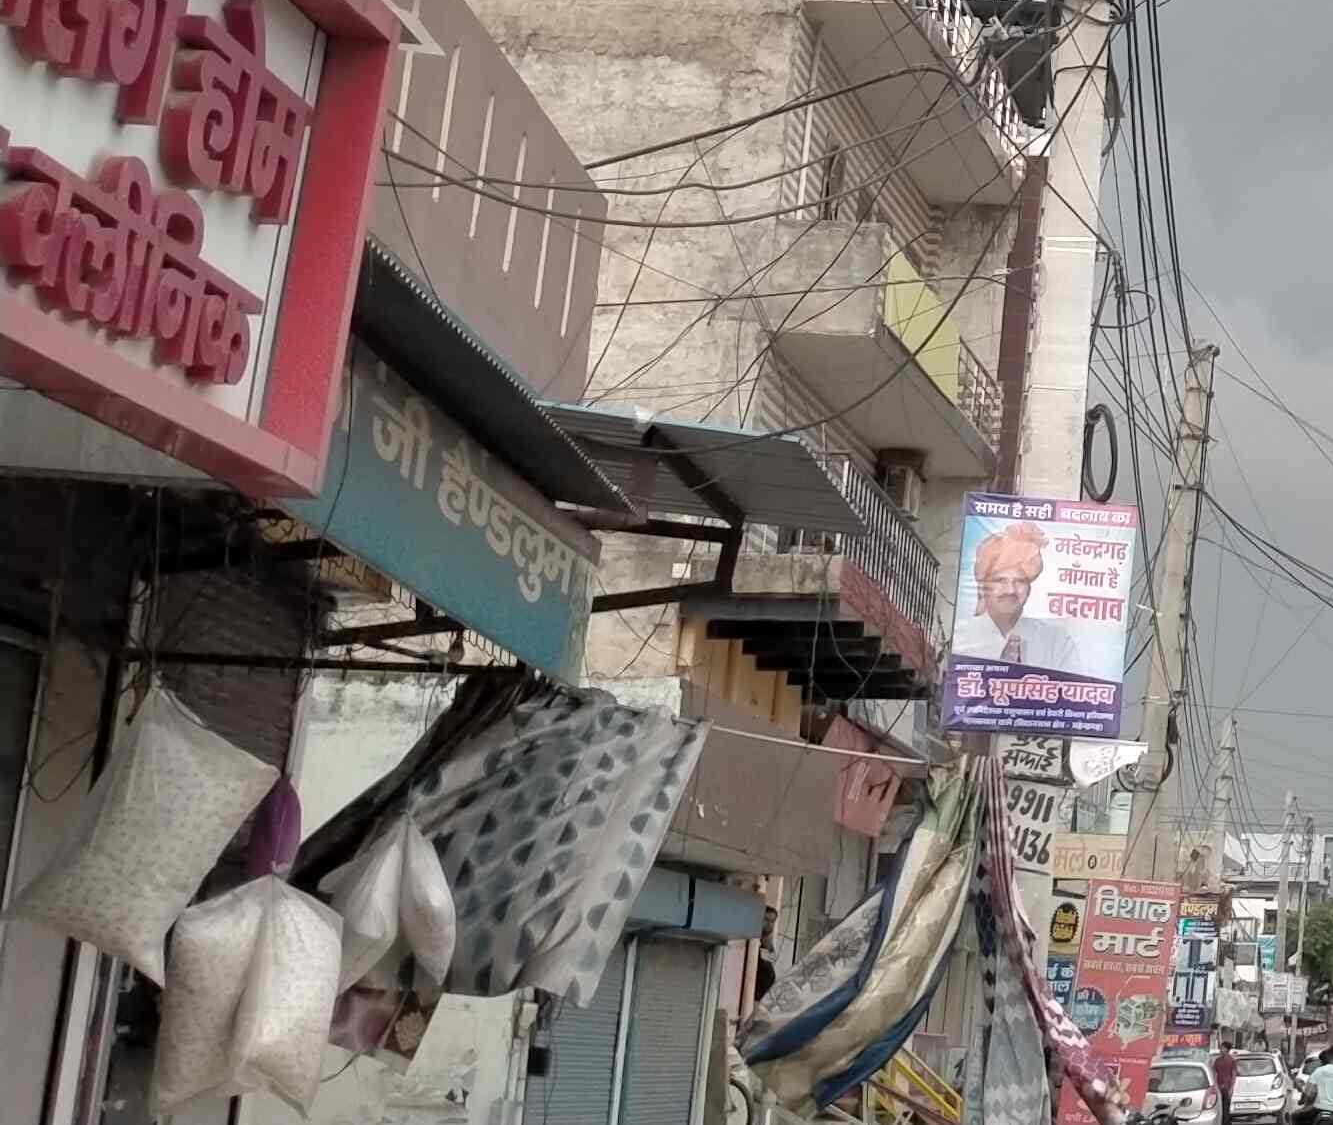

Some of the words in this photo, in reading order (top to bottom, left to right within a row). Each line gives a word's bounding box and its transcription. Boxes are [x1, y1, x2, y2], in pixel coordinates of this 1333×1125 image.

[975, 501, 1010, 516] समय
[1011, 502, 1023, 518] है
[1026, 504, 1053, 519] सही
[1054, 533, 1129, 566] महेन्द्रगढ़
[1107, 567, 1121, 589] है
[1048, 593, 1125, 621] बदलाव
[1060, 680, 1120, 705] यादव
[1007, 784, 1055, 823] 9911
[1094, 885, 1176, 923] विशाल
[1092, 927, 1164, 958] मार्ट
